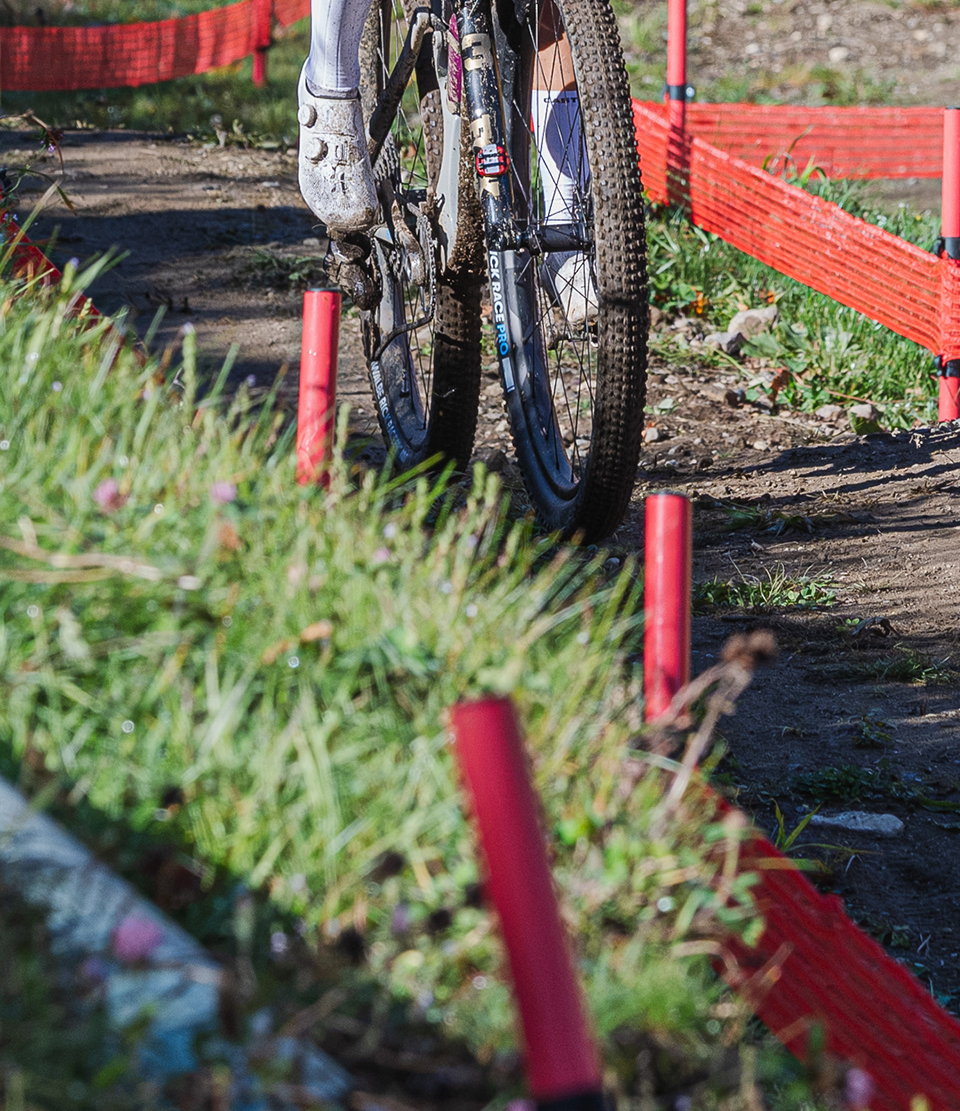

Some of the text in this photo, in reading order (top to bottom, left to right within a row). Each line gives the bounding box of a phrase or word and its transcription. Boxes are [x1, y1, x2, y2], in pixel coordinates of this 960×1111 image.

[488, 250, 509, 356] ICK RACE PRO
